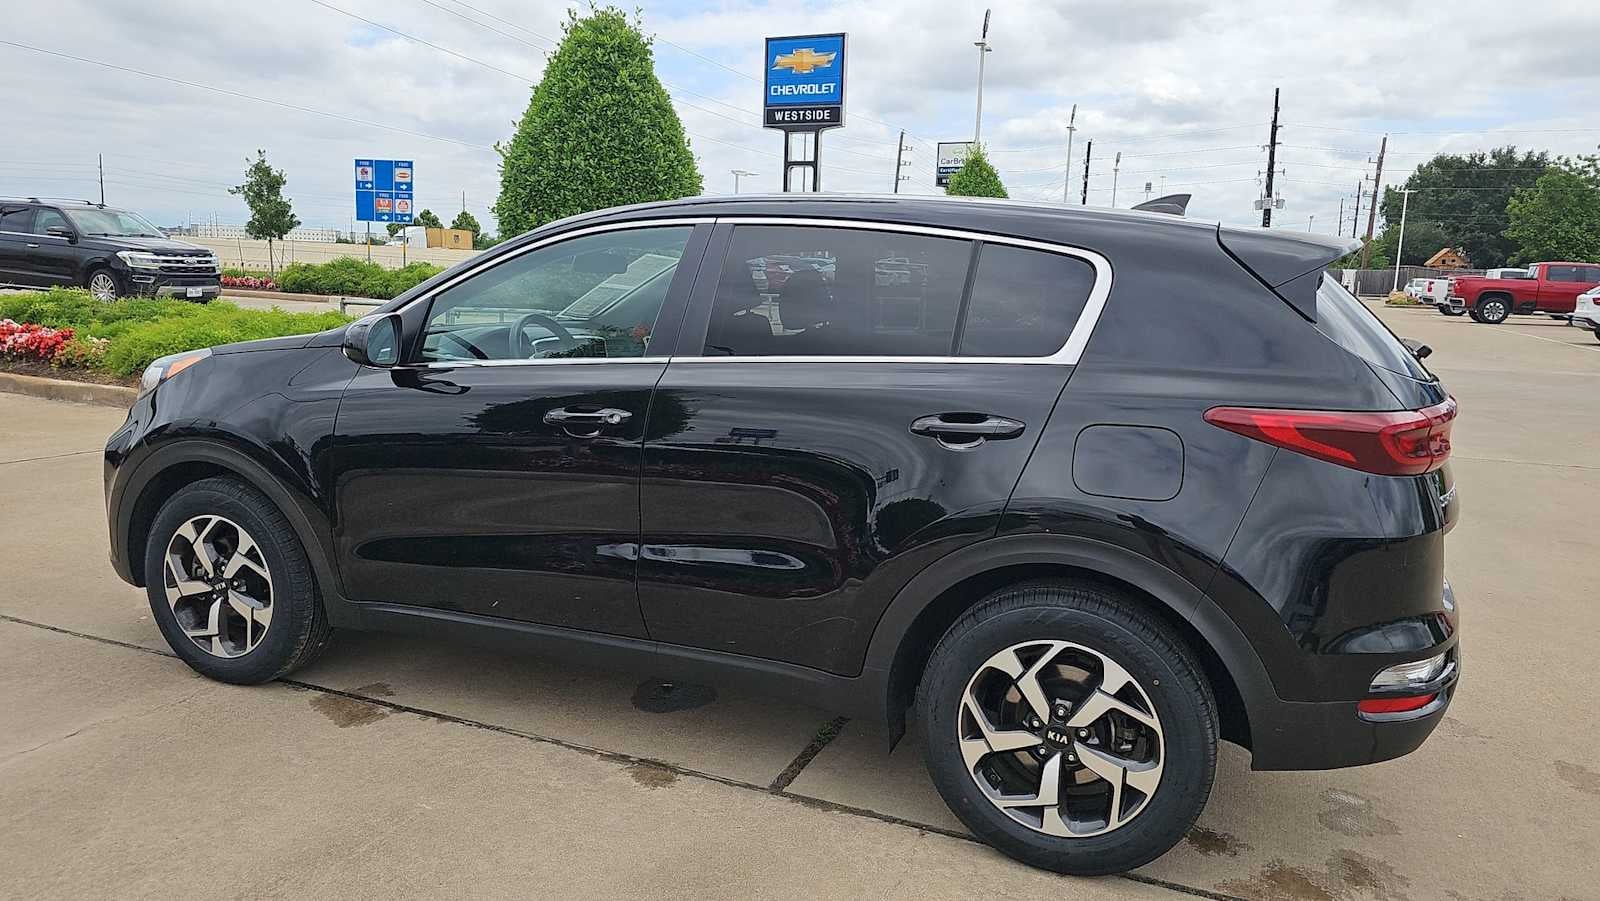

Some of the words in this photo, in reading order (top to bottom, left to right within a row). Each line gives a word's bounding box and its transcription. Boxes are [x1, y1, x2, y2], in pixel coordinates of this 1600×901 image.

[770, 83, 836, 96] CHEVROLET
[774, 109, 831, 121] WESTSIDE
[1047, 730, 1068, 745] KIA
